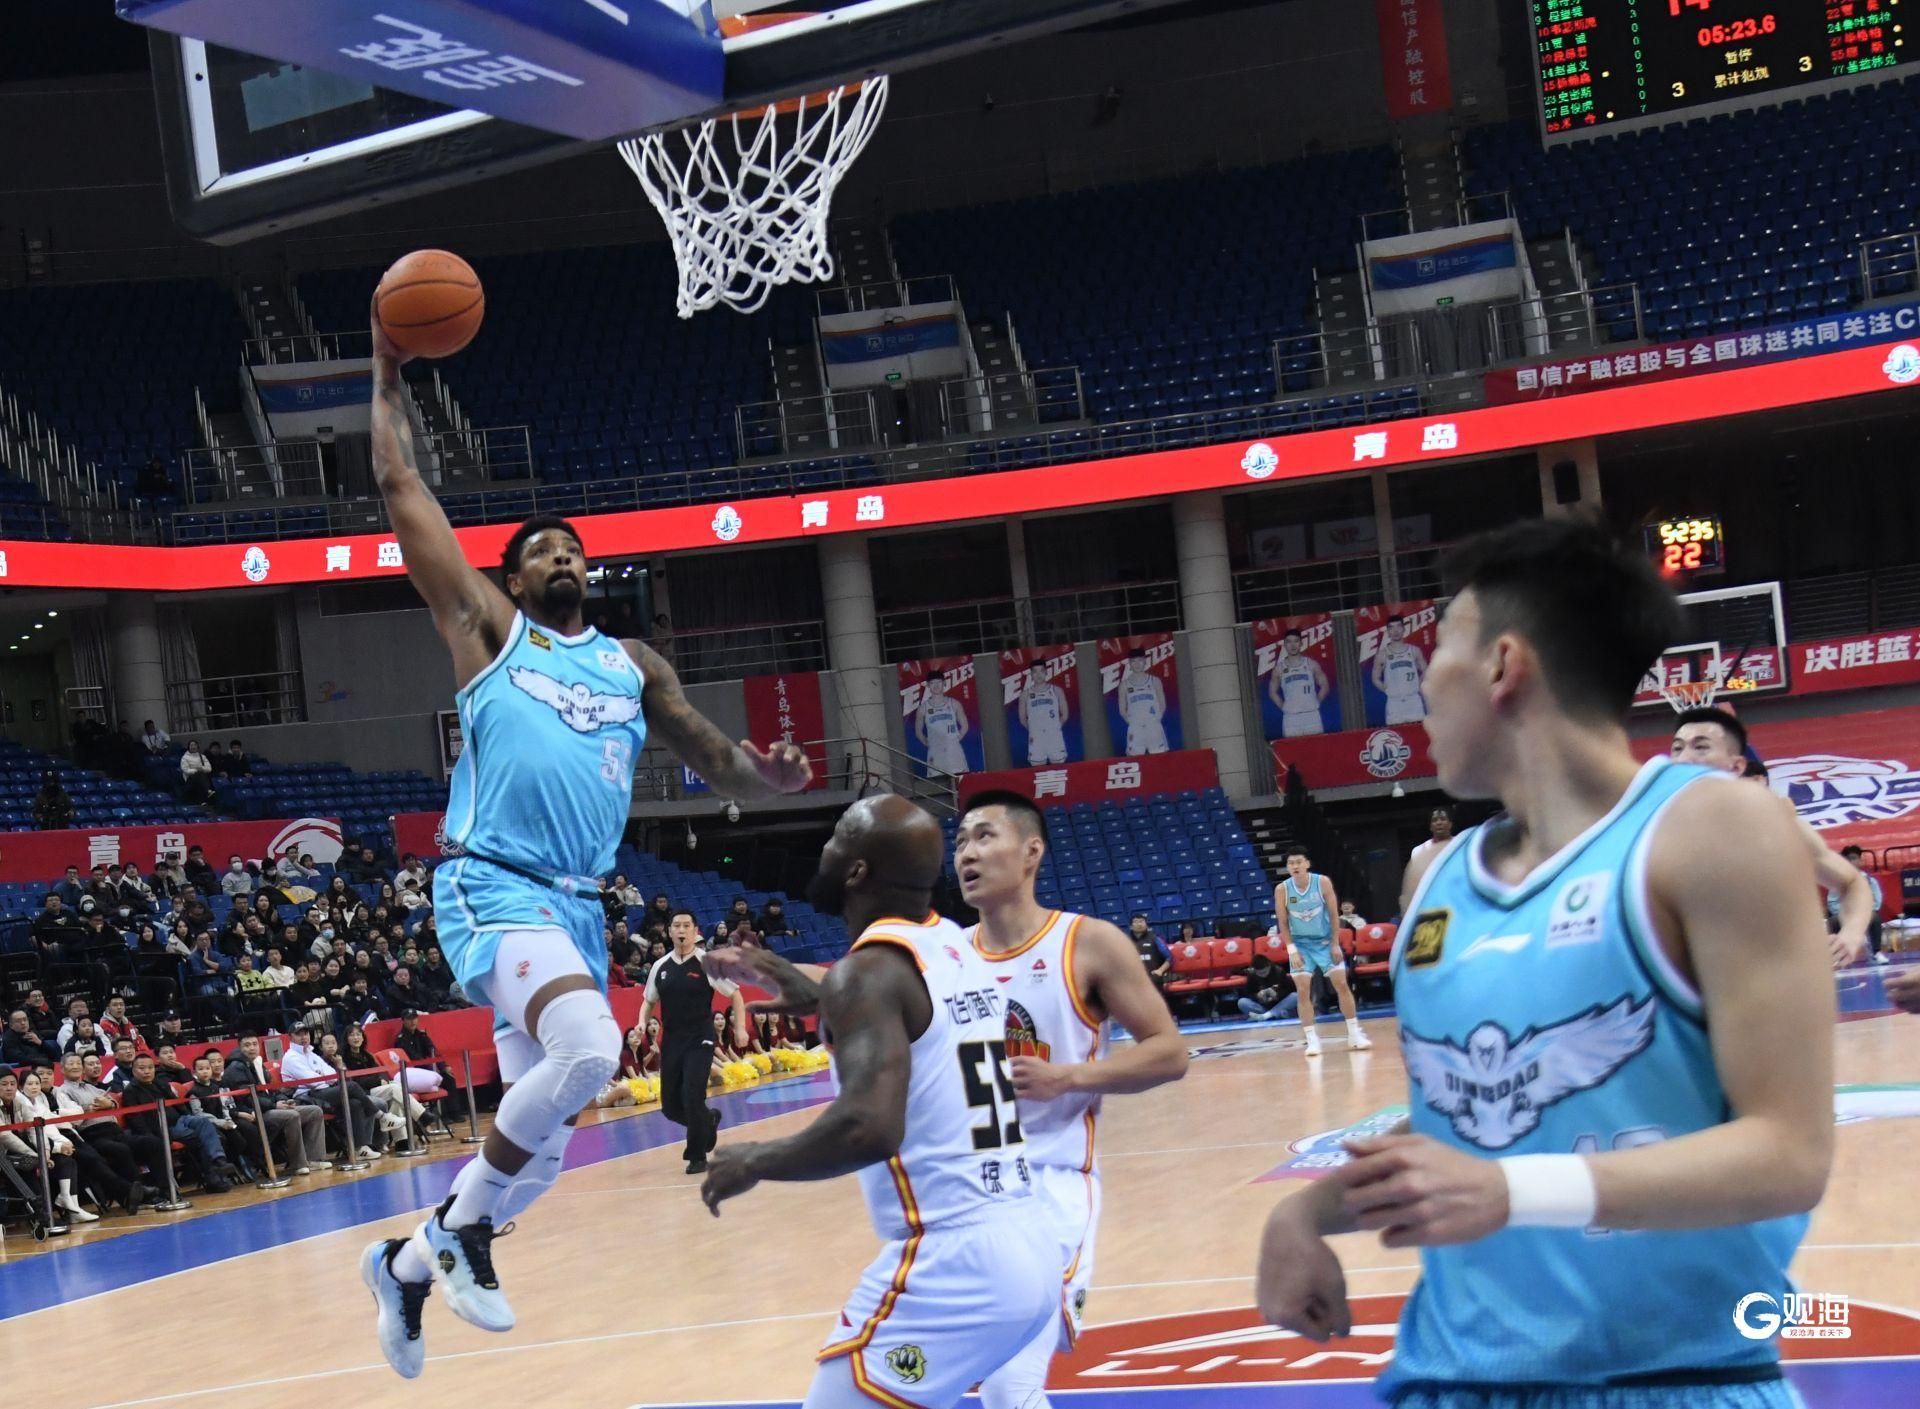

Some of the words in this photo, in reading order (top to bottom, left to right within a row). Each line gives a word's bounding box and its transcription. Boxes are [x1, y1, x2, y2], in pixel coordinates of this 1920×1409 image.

[1631, 23, 1639, 32] 0
[1698, 14, 1776, 46] 05:23.6
[1633, 36, 1640, 45] 0
[1400, 0, 1427, 104] 信产融控股
[1634, 50, 1642, 59] 0
[1725, 48, 1752, 65] 暂停
[1542, 68, 1554, 78] 14
[1636, 63, 1643, 73] 2
[1799, 56, 1813, 72] 3
[1637, 77, 1645, 86] 0
[1714, 66, 1770, 88] 累计犯规
[1639, 91, 1646, 100] 0
[1672, 82, 1685, 97] 3
[1517, 306, 1920, 391] 国信产融控股与全国球迷共同关注C
[1353, 423, 1458, 461] 青岛
[801, 495, 885, 528] 青岛
[325, 542, 404, 572] 青岛
[1664, 542, 1702, 570] 22
[1803, 635, 1920, 674] 决胜篮
[1033, 762, 1141, 799] 青岛
[88, 831, 187, 871] 青岛
